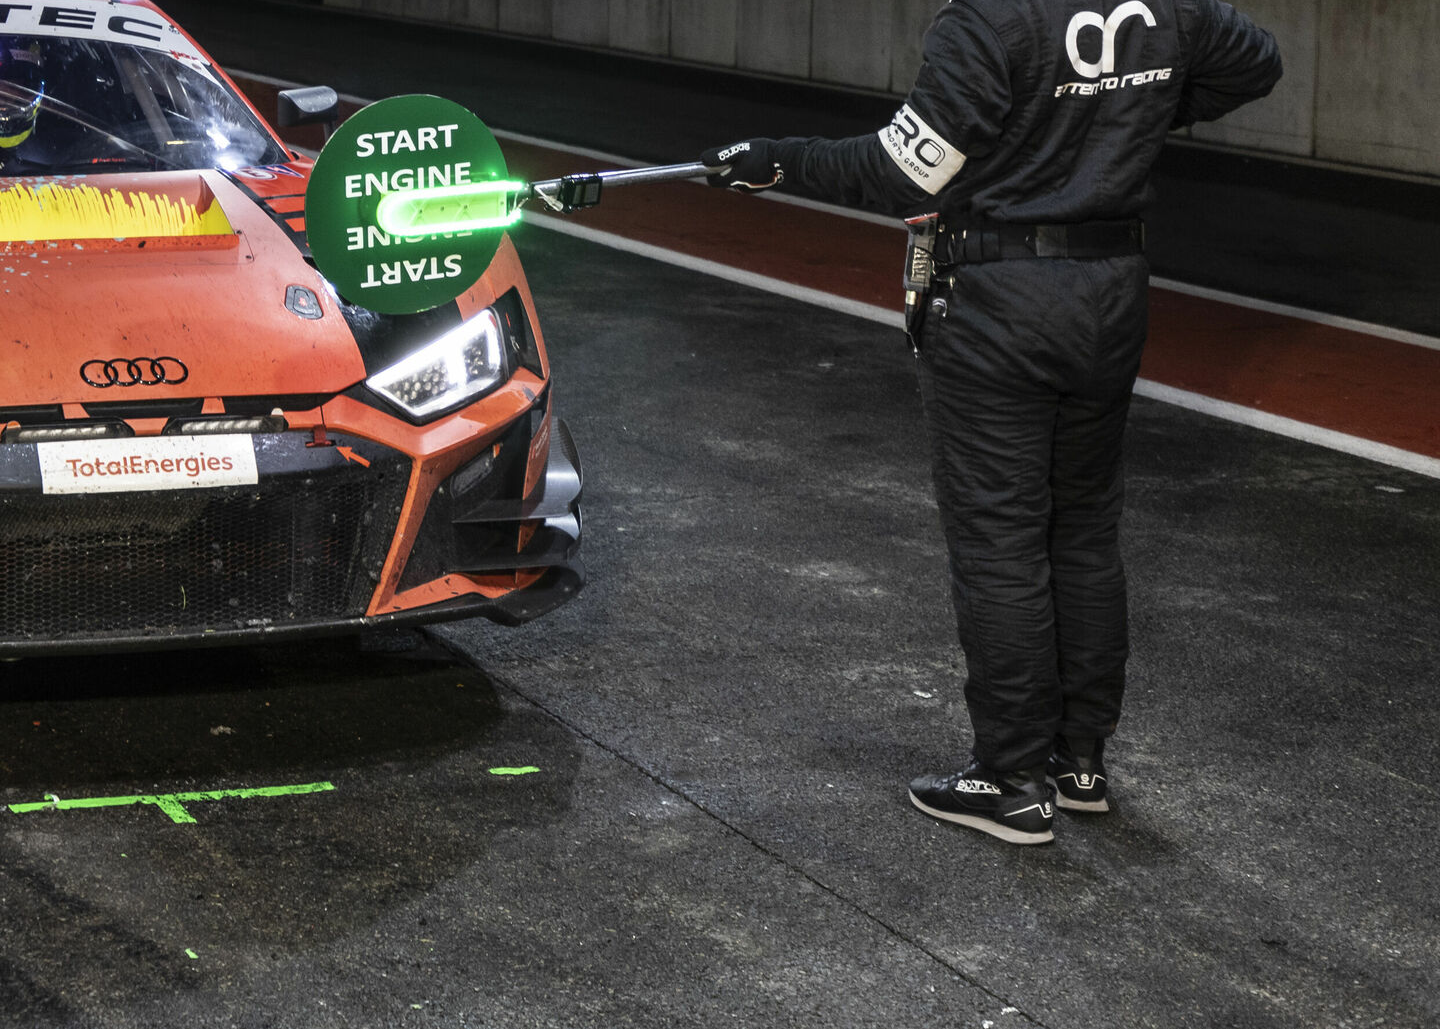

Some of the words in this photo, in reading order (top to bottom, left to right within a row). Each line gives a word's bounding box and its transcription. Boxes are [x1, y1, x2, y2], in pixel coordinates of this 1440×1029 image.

[356, 124, 459, 158] START
[344, 162, 472, 199] ENGINE
[904, 157, 930, 179] GROUP
[360, 254, 462, 289] START
[66, 453, 234, 481] TotalEnergies
[955, 779, 1002, 795] sparco
